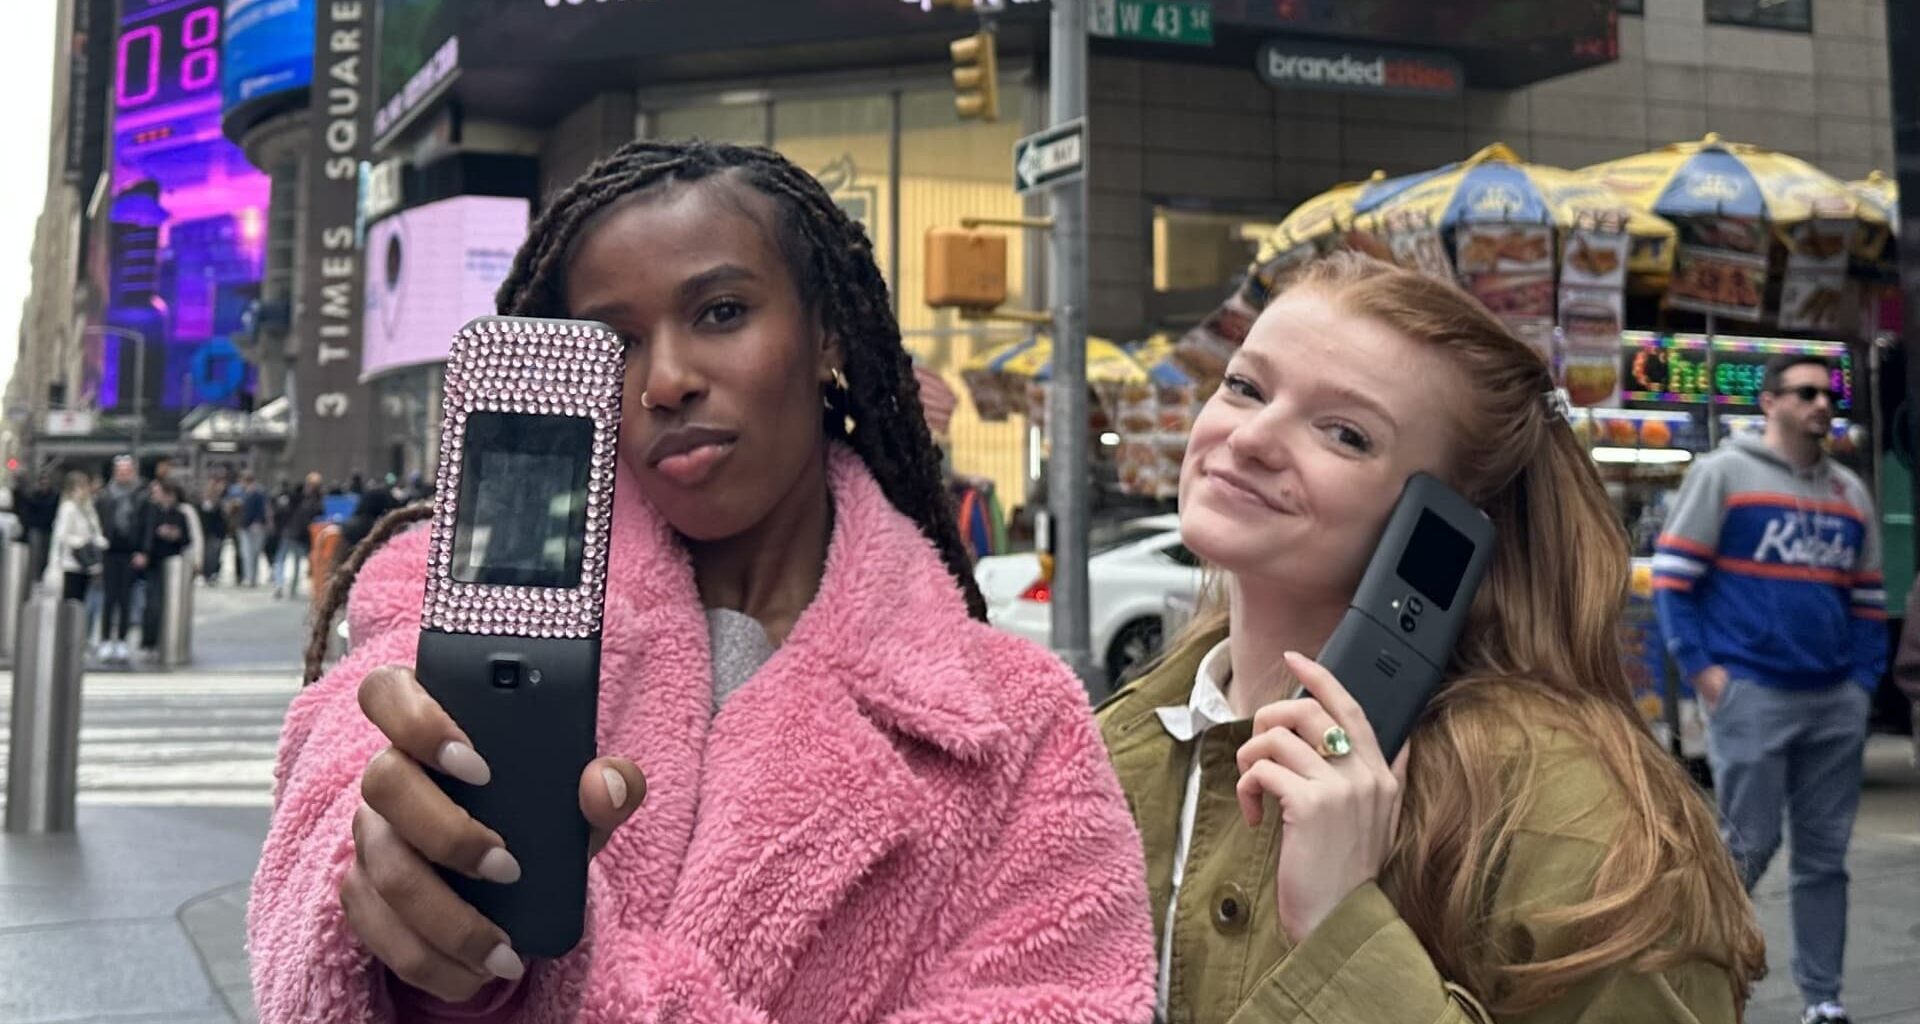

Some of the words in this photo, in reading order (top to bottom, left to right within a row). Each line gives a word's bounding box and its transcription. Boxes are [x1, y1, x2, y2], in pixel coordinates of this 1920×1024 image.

[1119, 3, 1142, 34] W
[1150, 5, 1182, 38] 43
[325, 2, 363, 180] SQUARE
[317, 225, 353, 367] TIMES
[315, 392, 348, 417] 3
